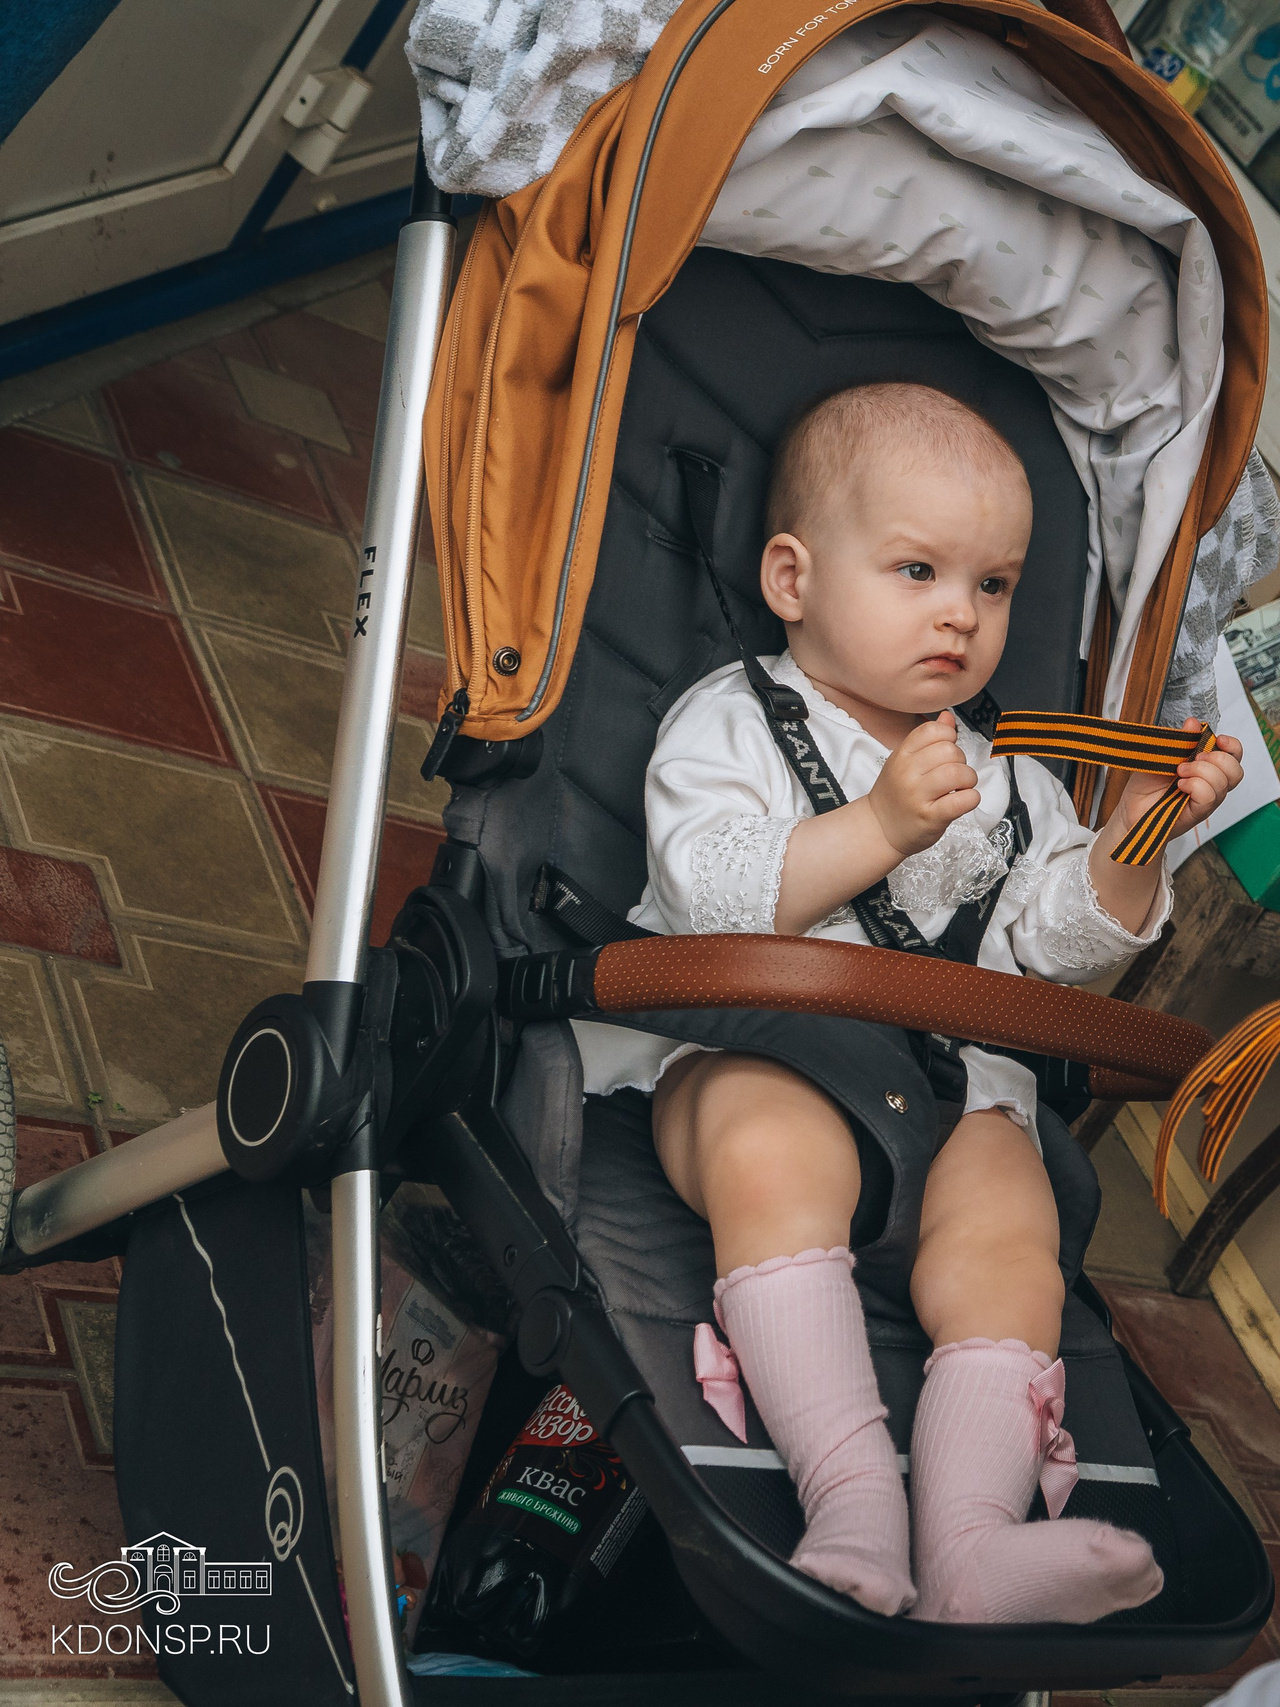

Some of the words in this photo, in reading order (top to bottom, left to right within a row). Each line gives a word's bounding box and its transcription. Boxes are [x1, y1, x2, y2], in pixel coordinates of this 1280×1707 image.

[758, 36, 798, 74] BORN
[796, 14, 828, 36] FOR
[353, 545, 377, 638] FLEX
[498, 1490, 533, 1507] ЖИВОГО
[533, 1499, 580, 1533] БРОЖЕНИЯ
